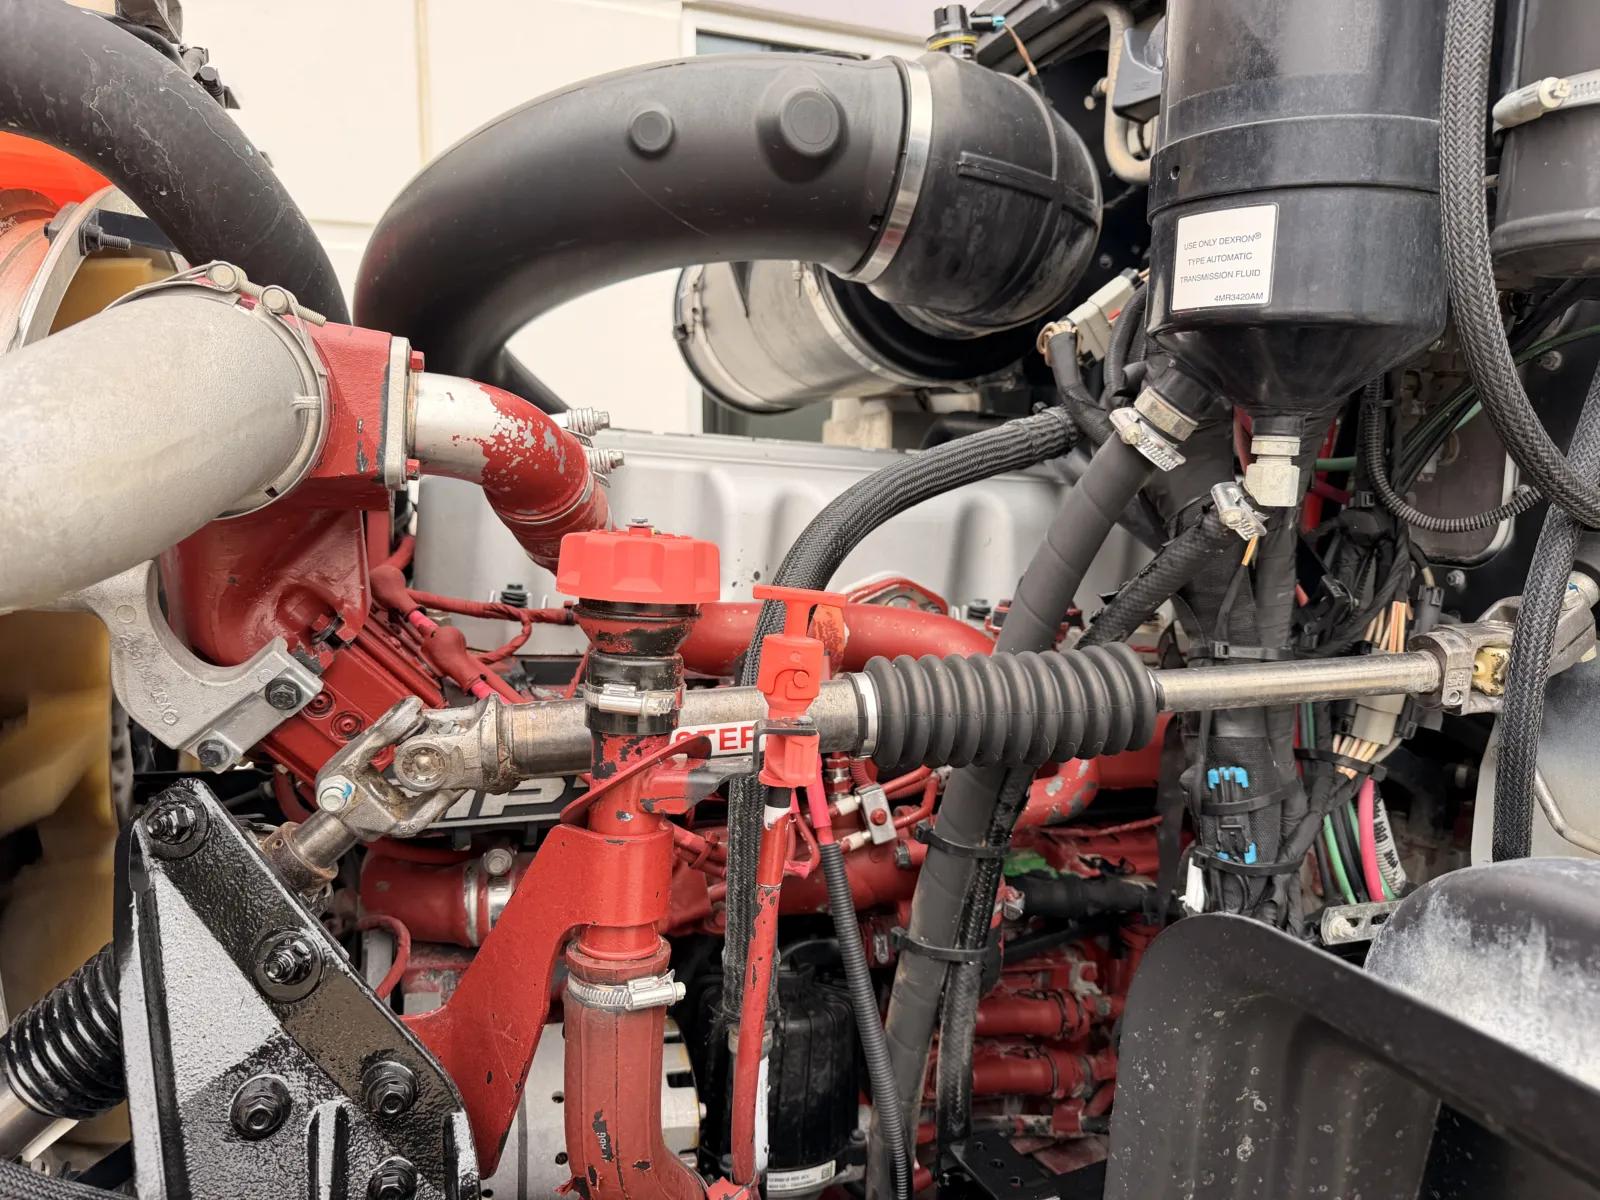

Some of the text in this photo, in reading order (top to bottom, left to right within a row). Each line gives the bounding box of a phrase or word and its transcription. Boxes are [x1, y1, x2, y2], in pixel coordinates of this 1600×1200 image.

[1184, 241, 1197, 250] USE
[1199, 238, 1217, 247] ONLY
[1188, 252, 1253, 266] TYPE AUTOMATIC
[1180, 269, 1261, 284] TRANSMISSION FLUID
